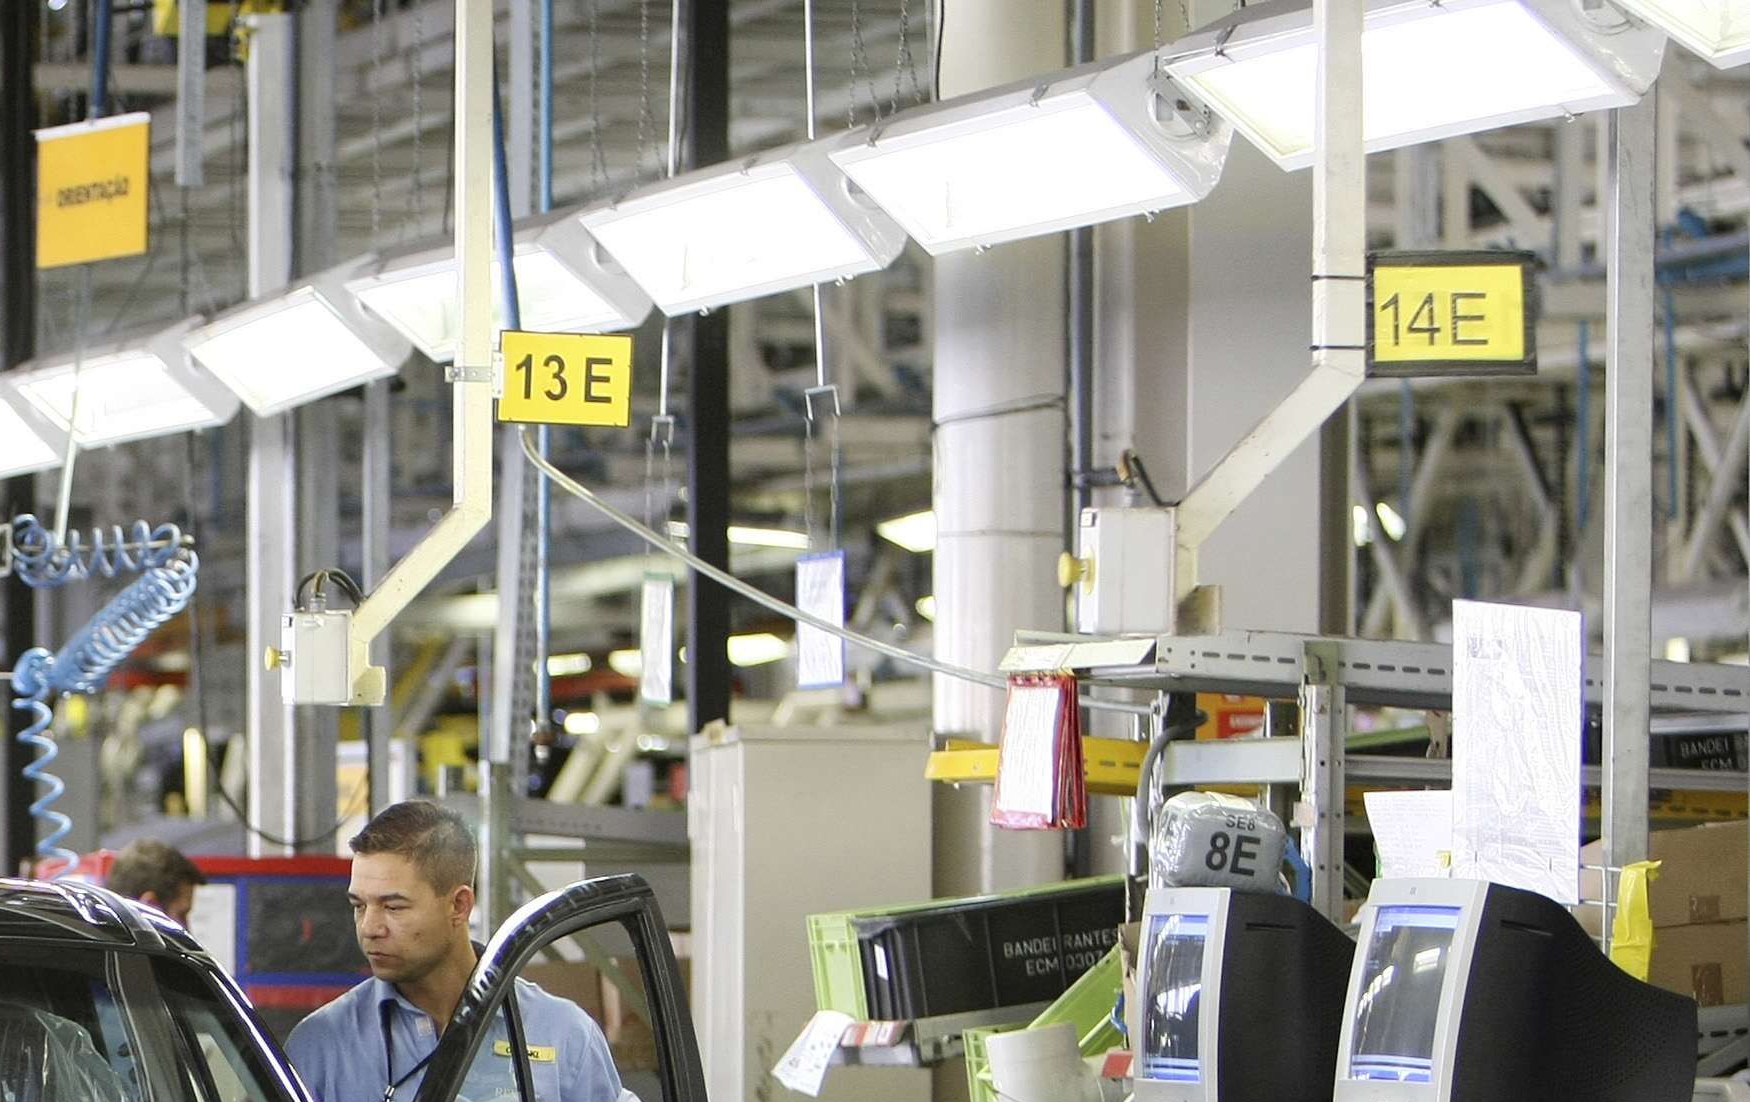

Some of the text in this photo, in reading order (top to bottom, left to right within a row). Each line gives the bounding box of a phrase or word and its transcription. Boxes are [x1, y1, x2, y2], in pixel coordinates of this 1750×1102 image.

[1379, 292, 1489, 346] 14E
[515, 353, 613, 404] 13 E
[1225, 814, 1256, 832] SE8
[1205, 831, 1261, 877] 8E
[1026, 956, 1060, 976] ECM
